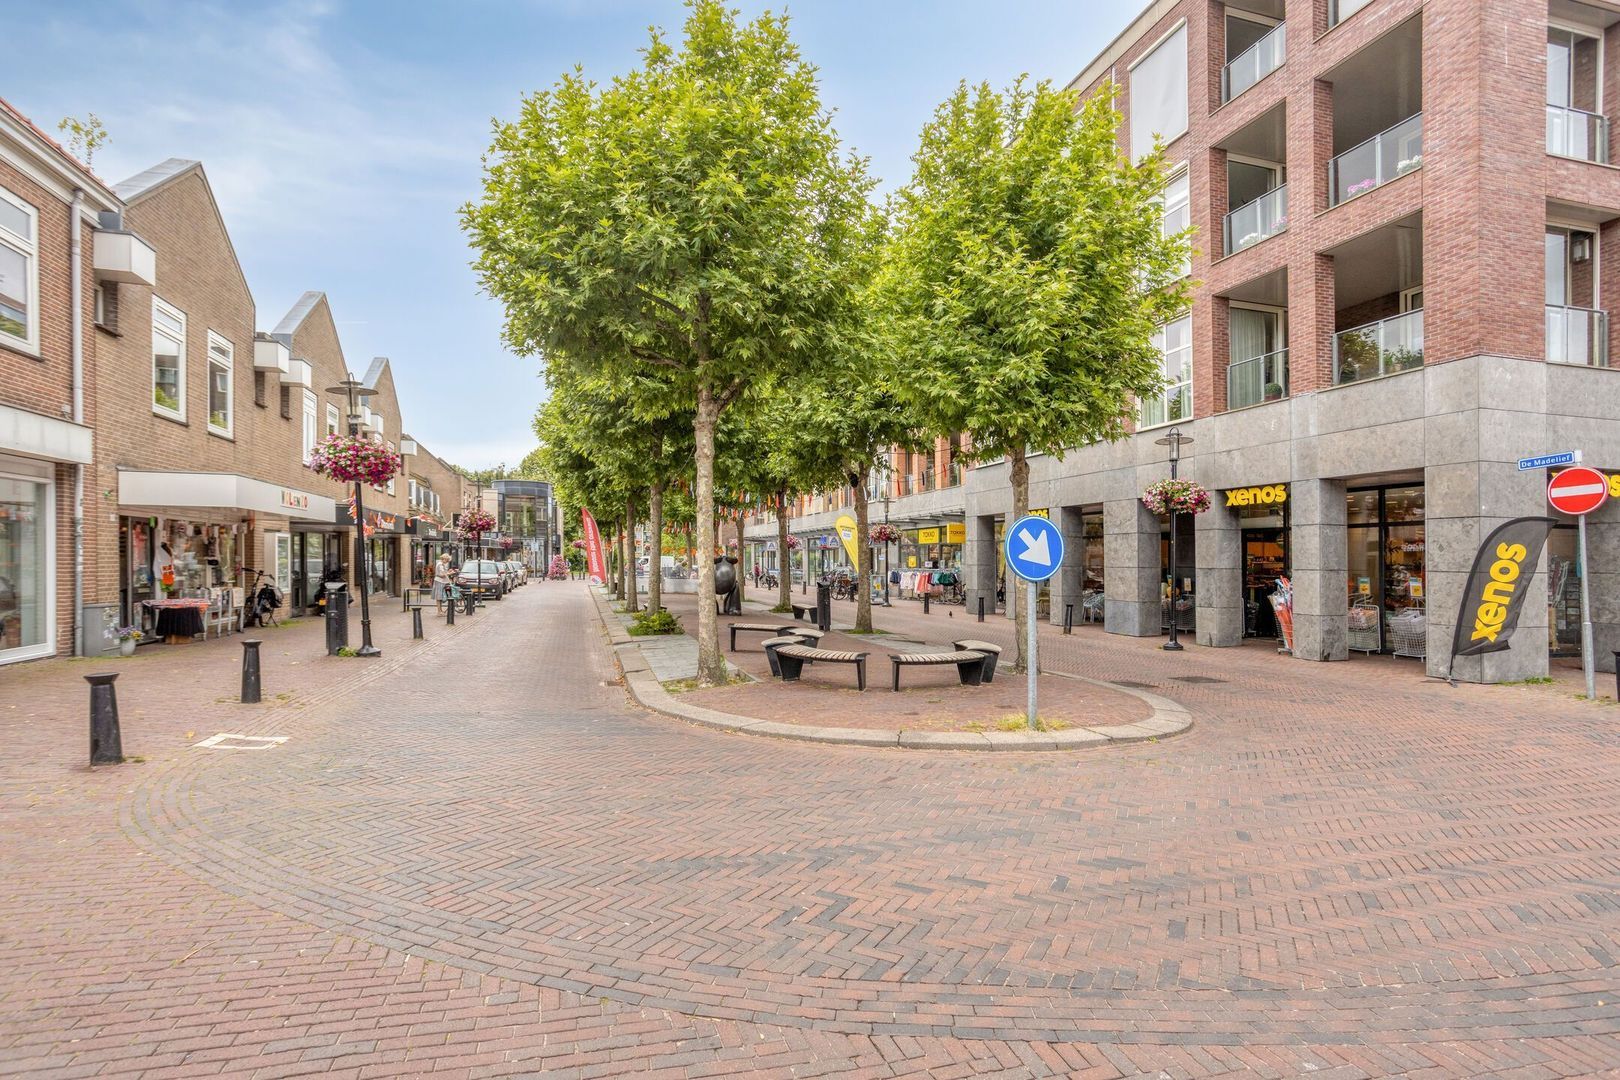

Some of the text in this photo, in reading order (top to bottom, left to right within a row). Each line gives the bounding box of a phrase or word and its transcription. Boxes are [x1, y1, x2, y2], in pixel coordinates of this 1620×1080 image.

[1533, 454, 1570, 466] Madelief
[1225, 484, 1287, 507] xenos
[1471, 542, 1527, 643] xenos
